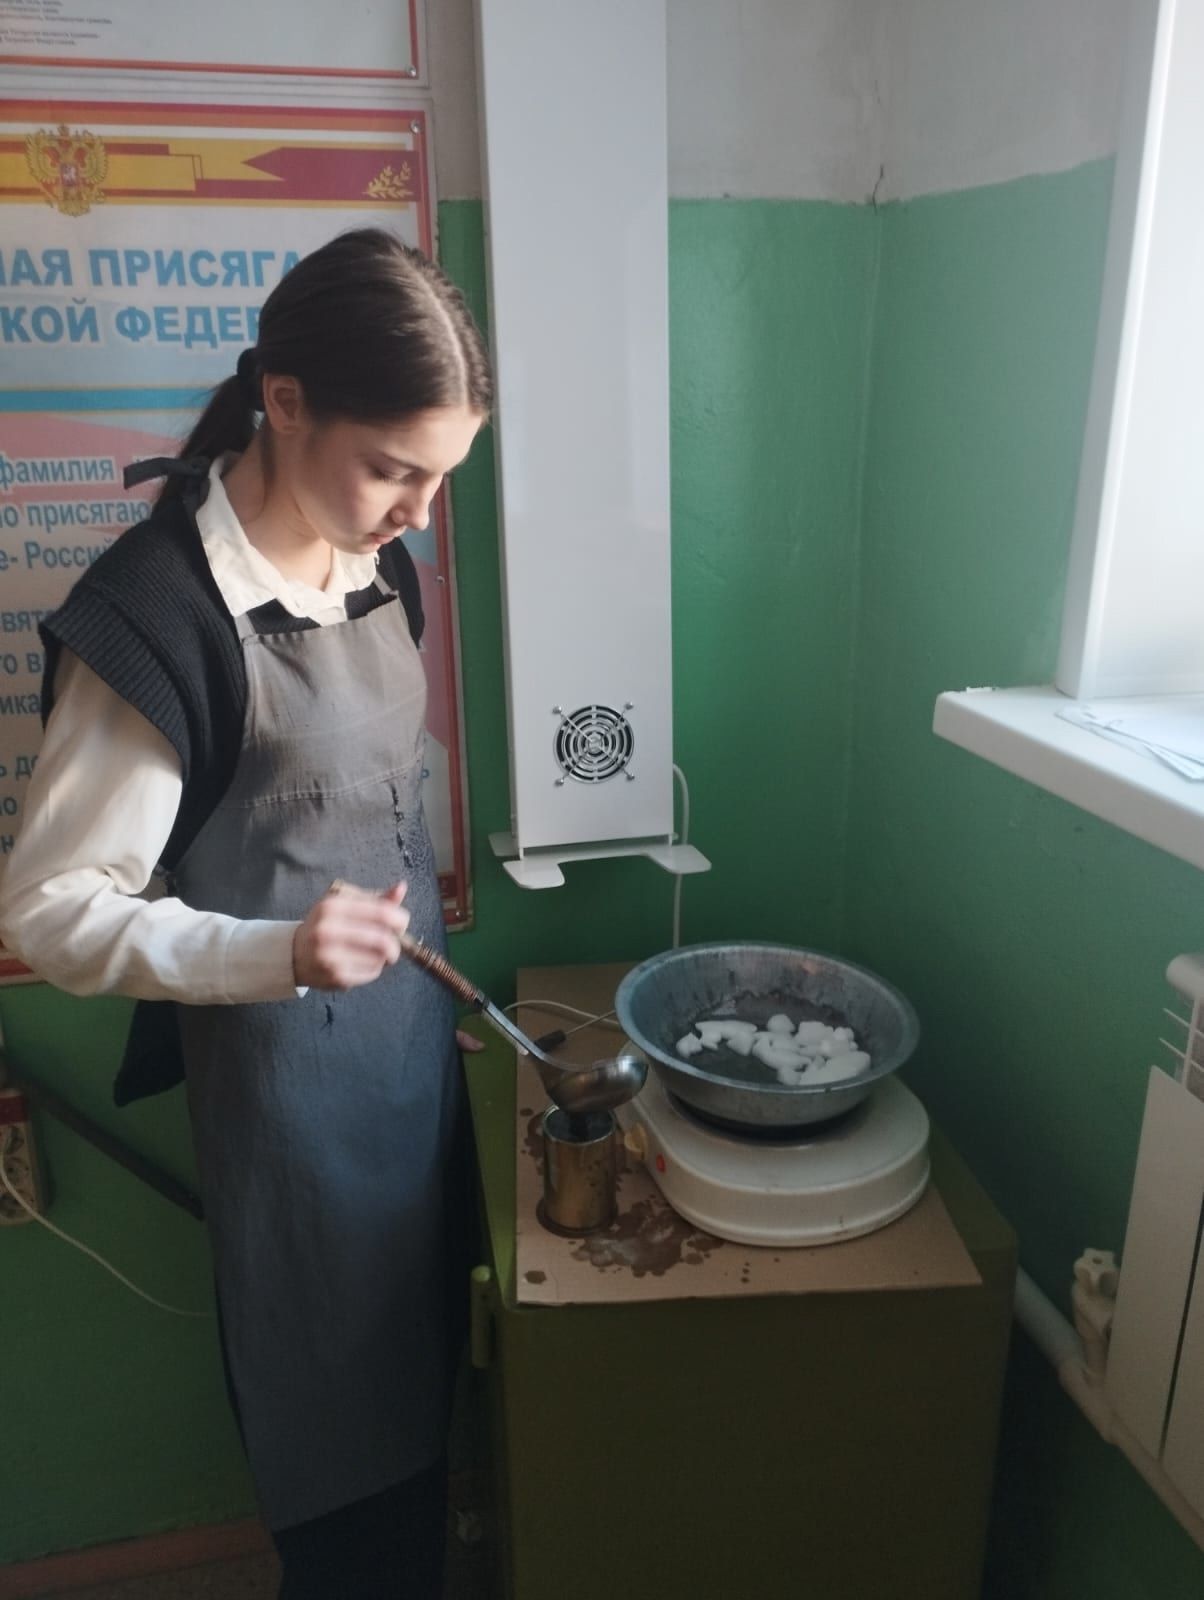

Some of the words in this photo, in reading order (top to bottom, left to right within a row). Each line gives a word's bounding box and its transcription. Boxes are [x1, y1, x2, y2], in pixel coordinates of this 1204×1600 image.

[0, 249, 73, 287] АЯ
[0, 297, 99, 343] КОЙ
[0, 456, 115, 489] фамилия
[24, 536, 113, 569] Росси
